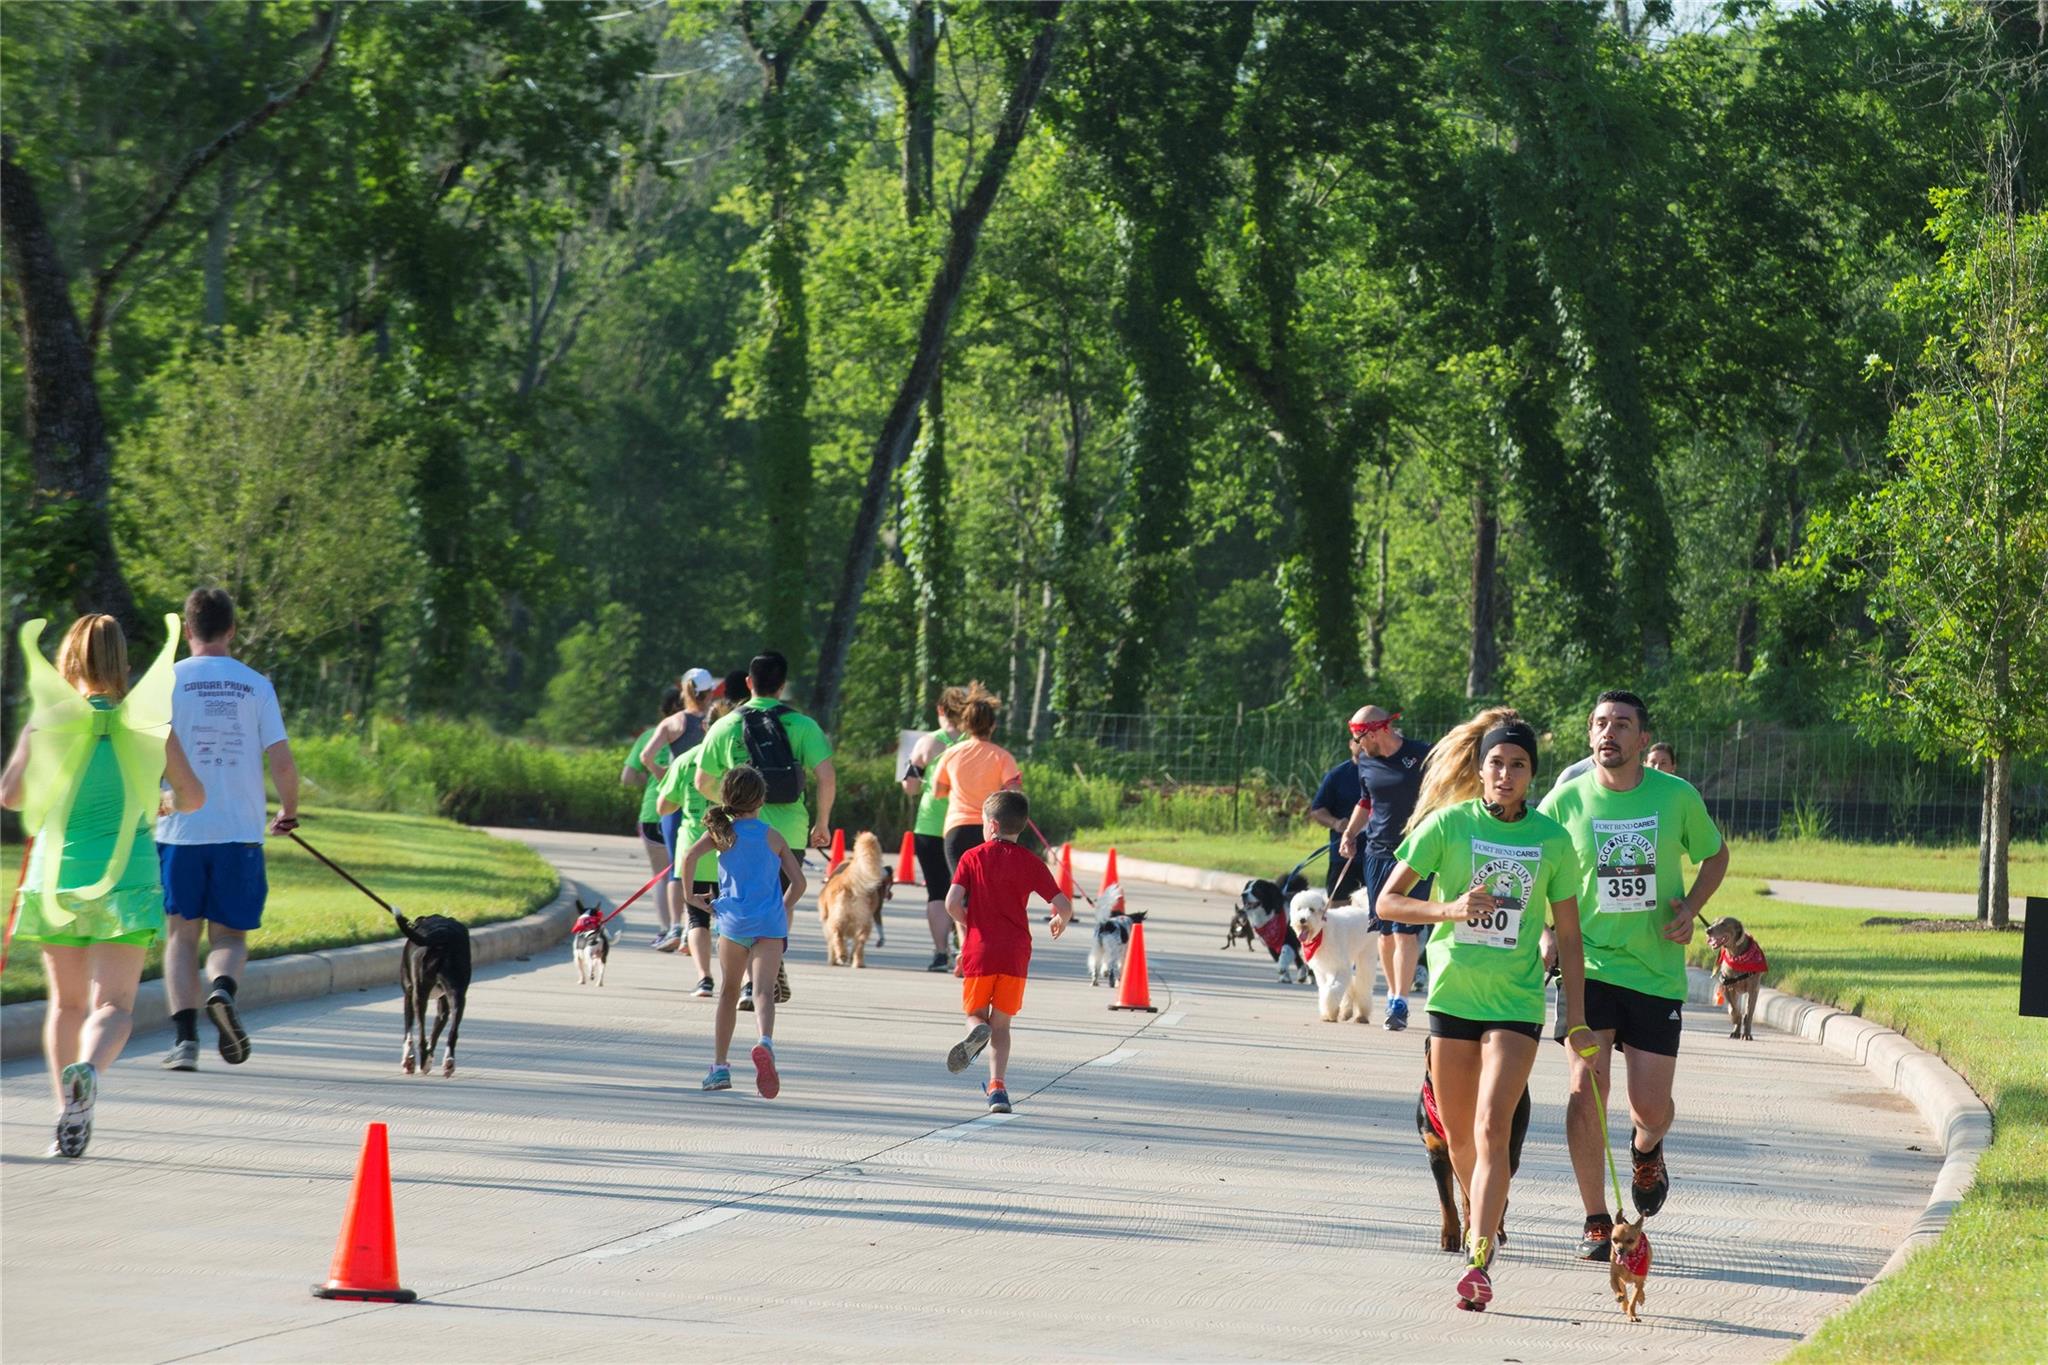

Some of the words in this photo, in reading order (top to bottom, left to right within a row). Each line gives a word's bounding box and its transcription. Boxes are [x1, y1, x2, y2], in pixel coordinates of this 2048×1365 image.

[184, 680, 222, 692] COUGAR
[1633, 819, 1656, 829] CARES
[1474, 843, 1495, 853] FORT
[1495, 847, 1515, 857] BEND
[1515, 850, 1539, 858] CARES
[1630, 834, 1652, 852] FUN
[1511, 861, 1531, 884] FUN
[1608, 877, 1647, 898] 359
